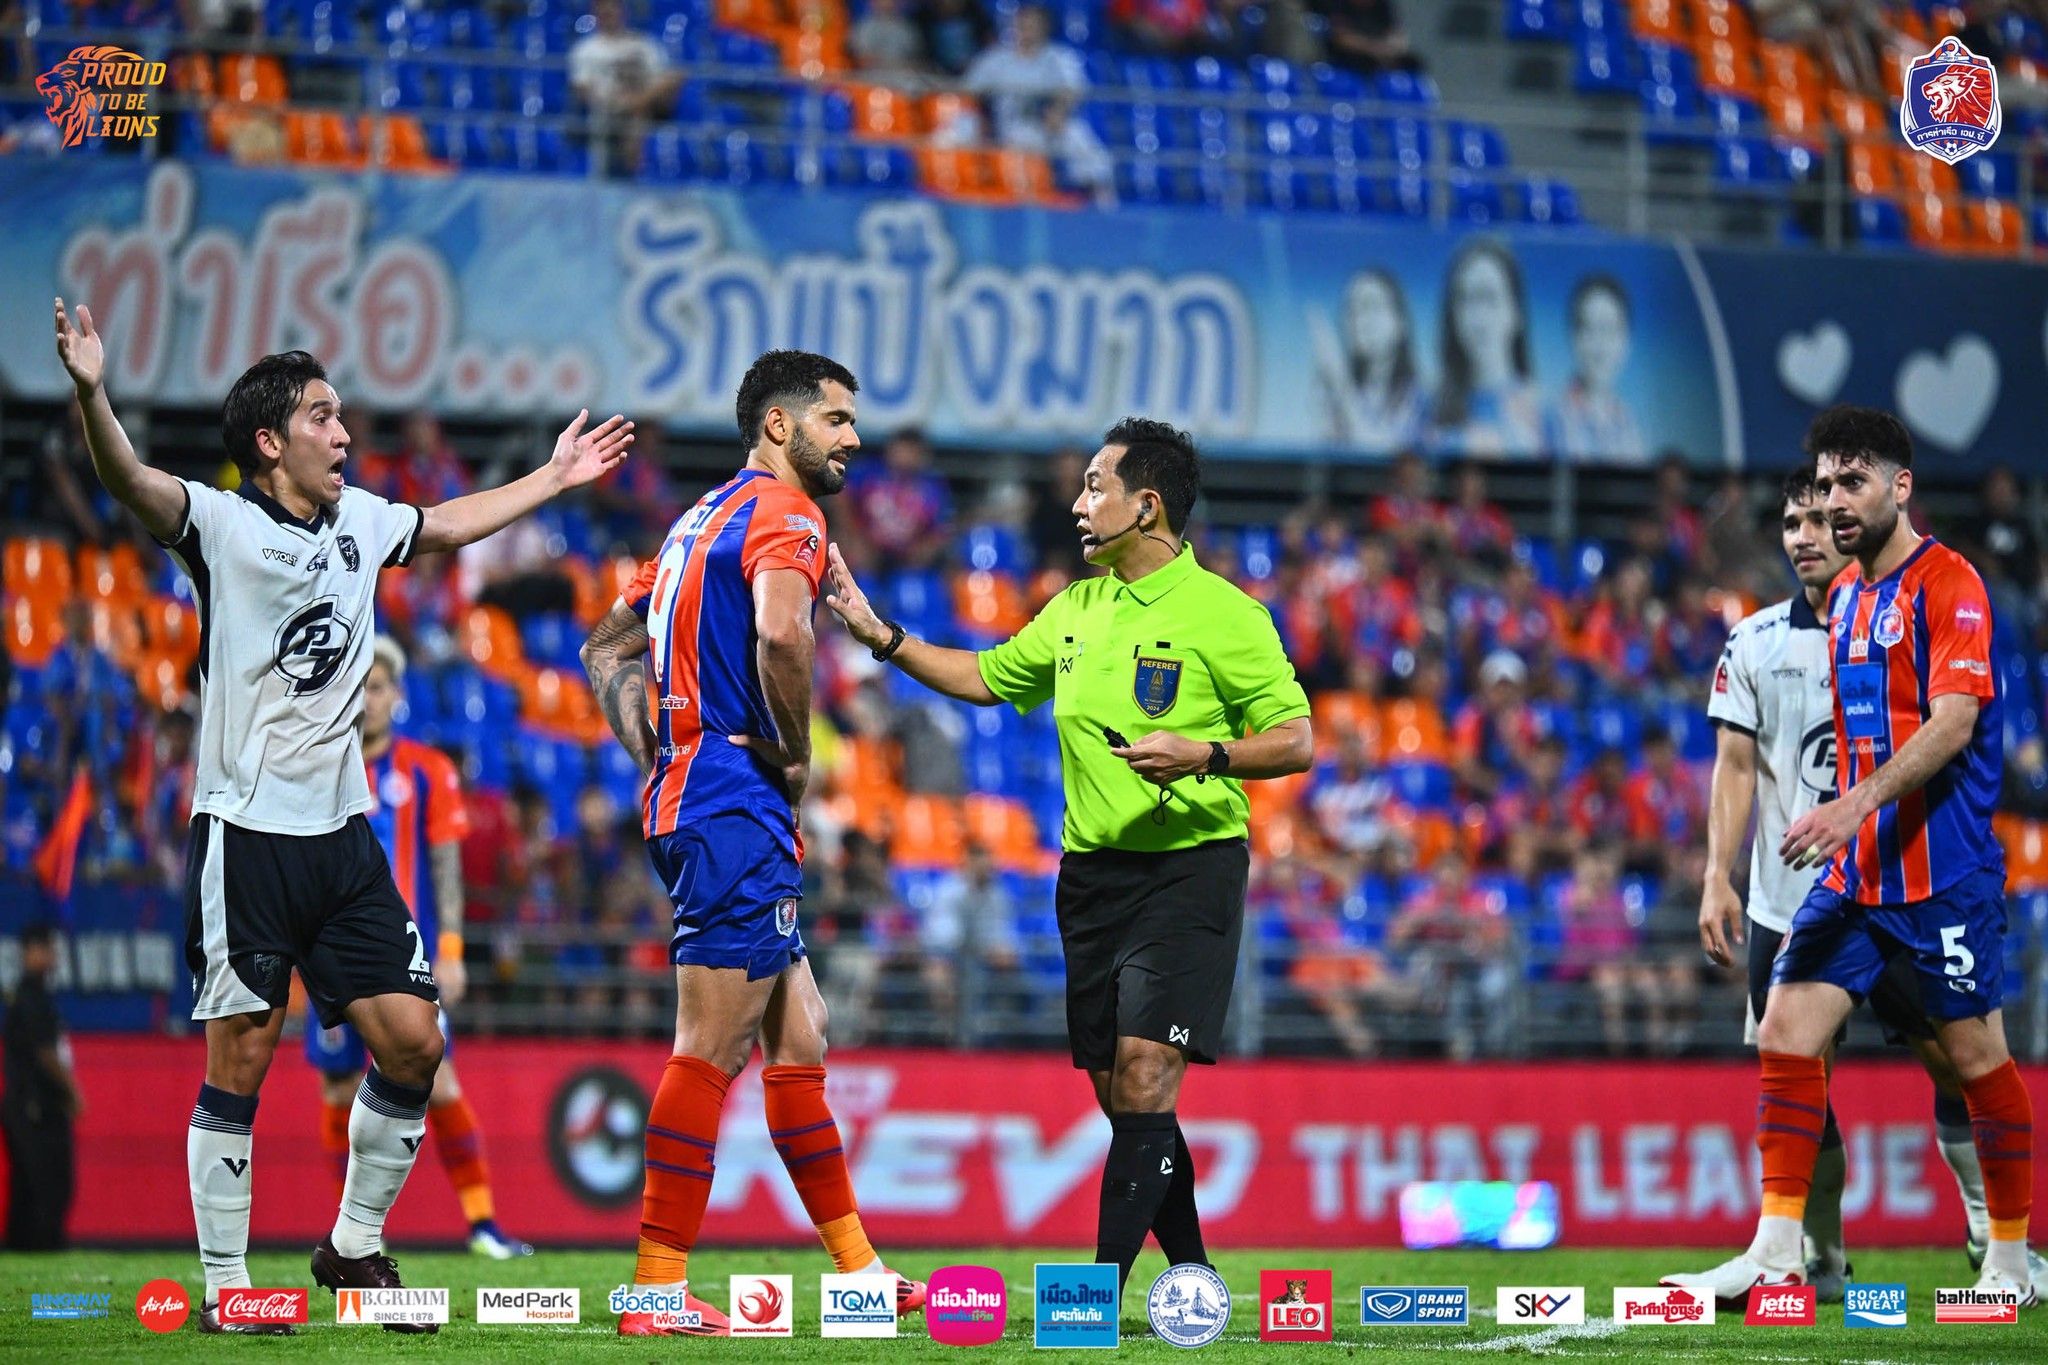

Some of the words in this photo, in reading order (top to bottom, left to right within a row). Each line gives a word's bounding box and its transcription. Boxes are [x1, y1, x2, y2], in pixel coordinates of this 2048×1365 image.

[1141, 660, 1178, 671] REFEREE
[406, 921, 430, 974] 2
[1940, 924, 1975, 977] 5
[1572, 1124, 1936, 1221] LEAUE
